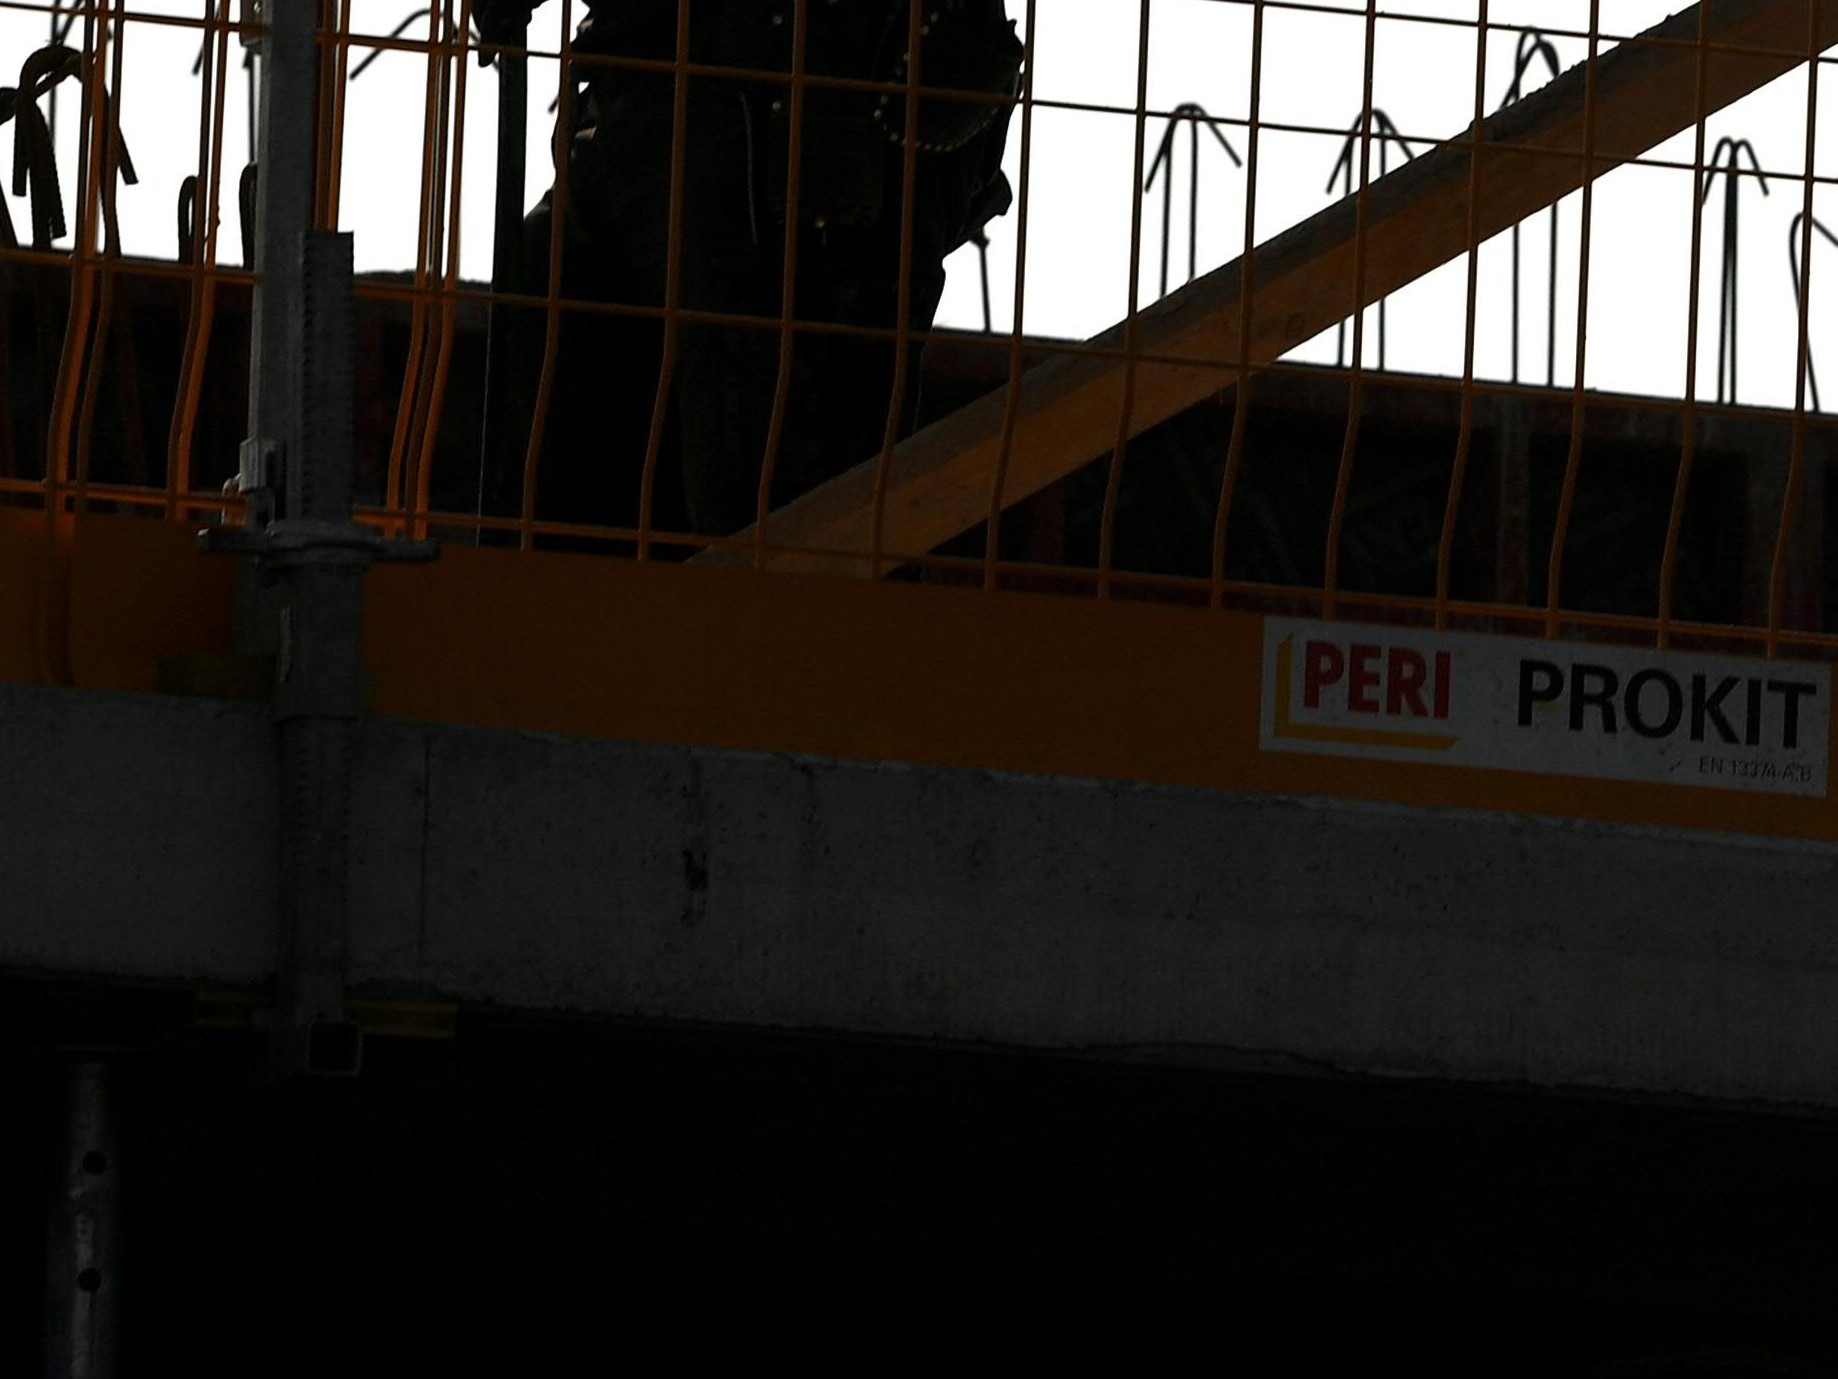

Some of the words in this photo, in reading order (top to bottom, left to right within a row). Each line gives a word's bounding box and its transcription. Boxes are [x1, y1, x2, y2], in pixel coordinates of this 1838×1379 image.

[1303, 640, 1451, 718] PERI
[1518, 658, 1817, 749] PROKIT
[1699, 756, 1724, 775] EN
